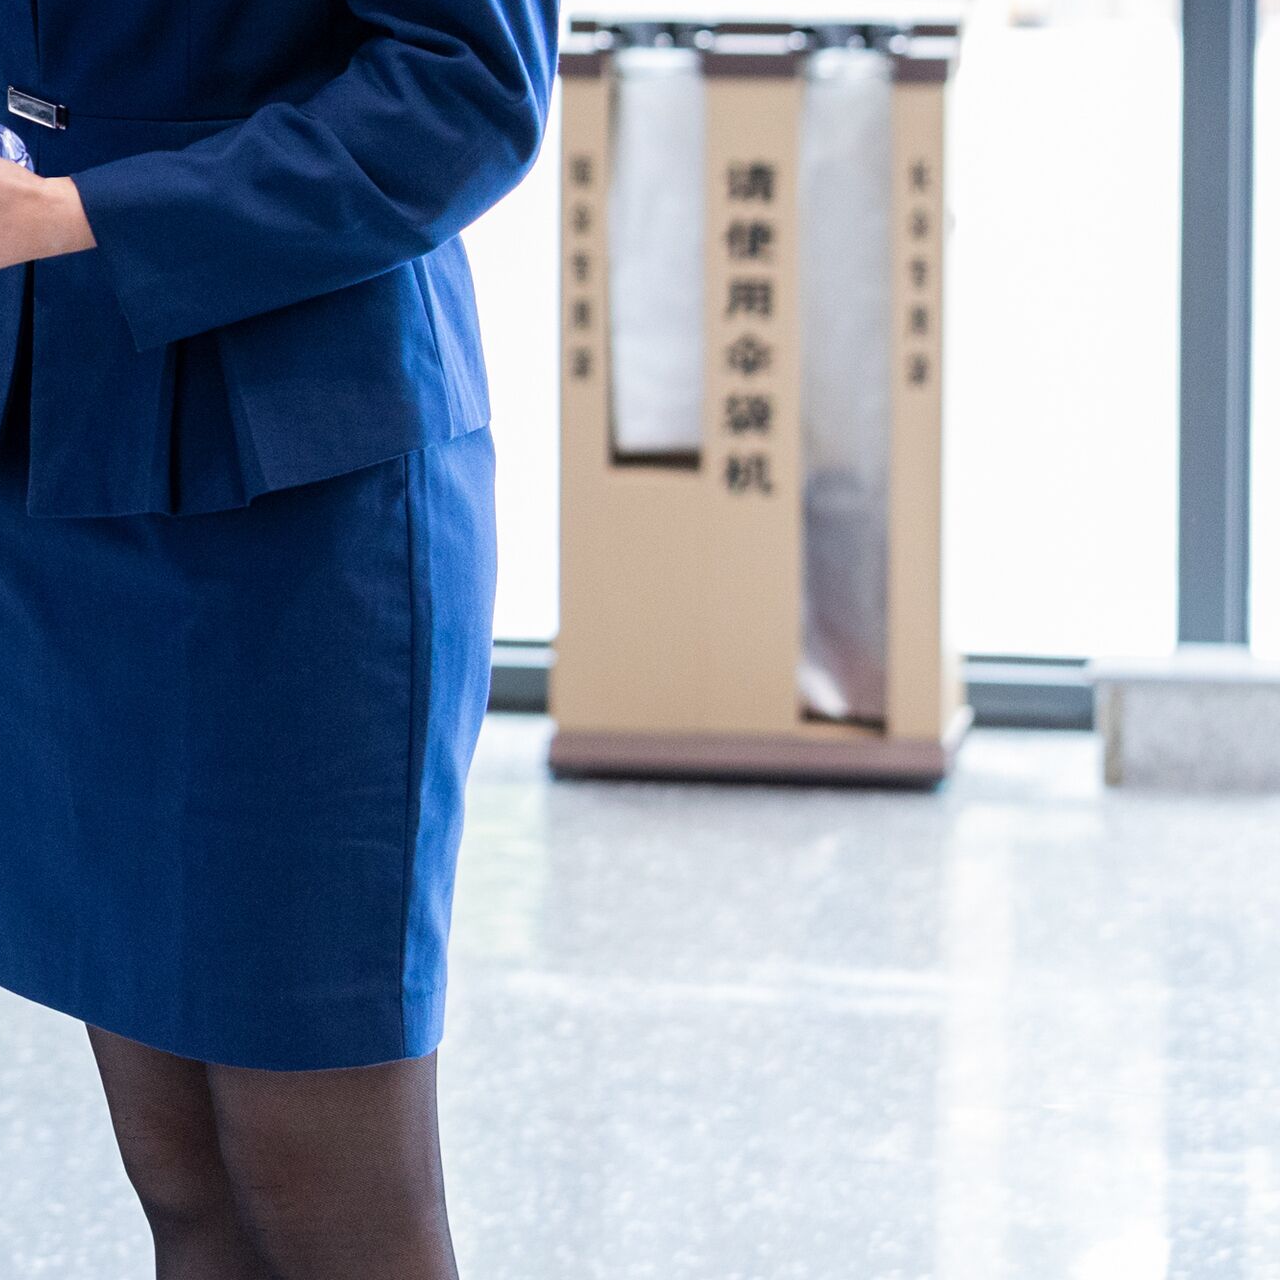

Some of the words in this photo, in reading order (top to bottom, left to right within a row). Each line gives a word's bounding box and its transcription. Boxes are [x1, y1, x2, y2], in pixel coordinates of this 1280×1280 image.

[725, 160, 776, 496] 请使用伞袋机
